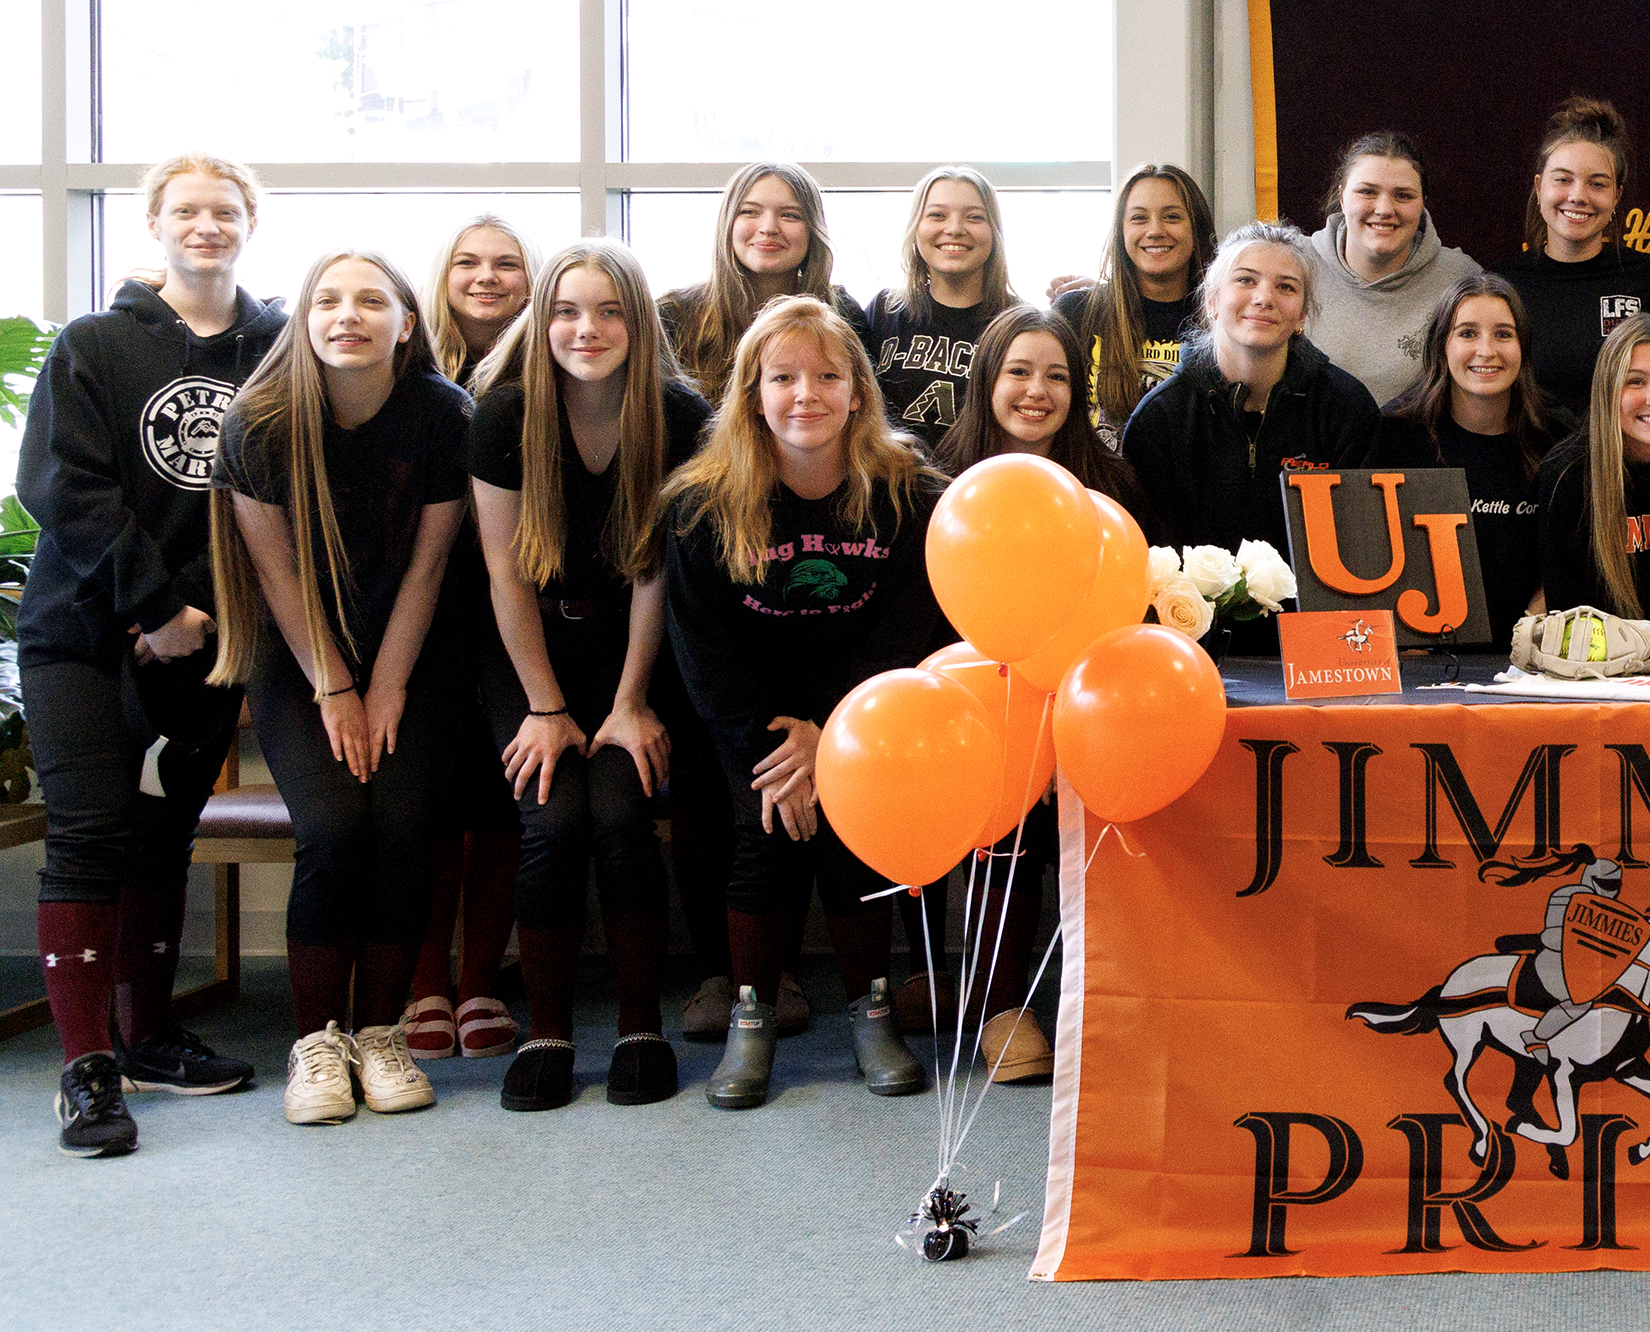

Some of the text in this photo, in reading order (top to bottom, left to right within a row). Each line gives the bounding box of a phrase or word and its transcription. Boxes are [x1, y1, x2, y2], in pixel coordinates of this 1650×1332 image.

[1602, 298, 1639, 318] LFS
[875, 335, 979, 379] D-BAC
[1141, 348, 1160, 359] RD
[161, 389, 232, 421] PETR
[156, 434, 214, 477] MAR
[1470, 499, 1540, 515] Kettle Cor
[1287, 662, 1392, 690] JAMESTOWN
[1567, 903, 1644, 946] JIMMIES
